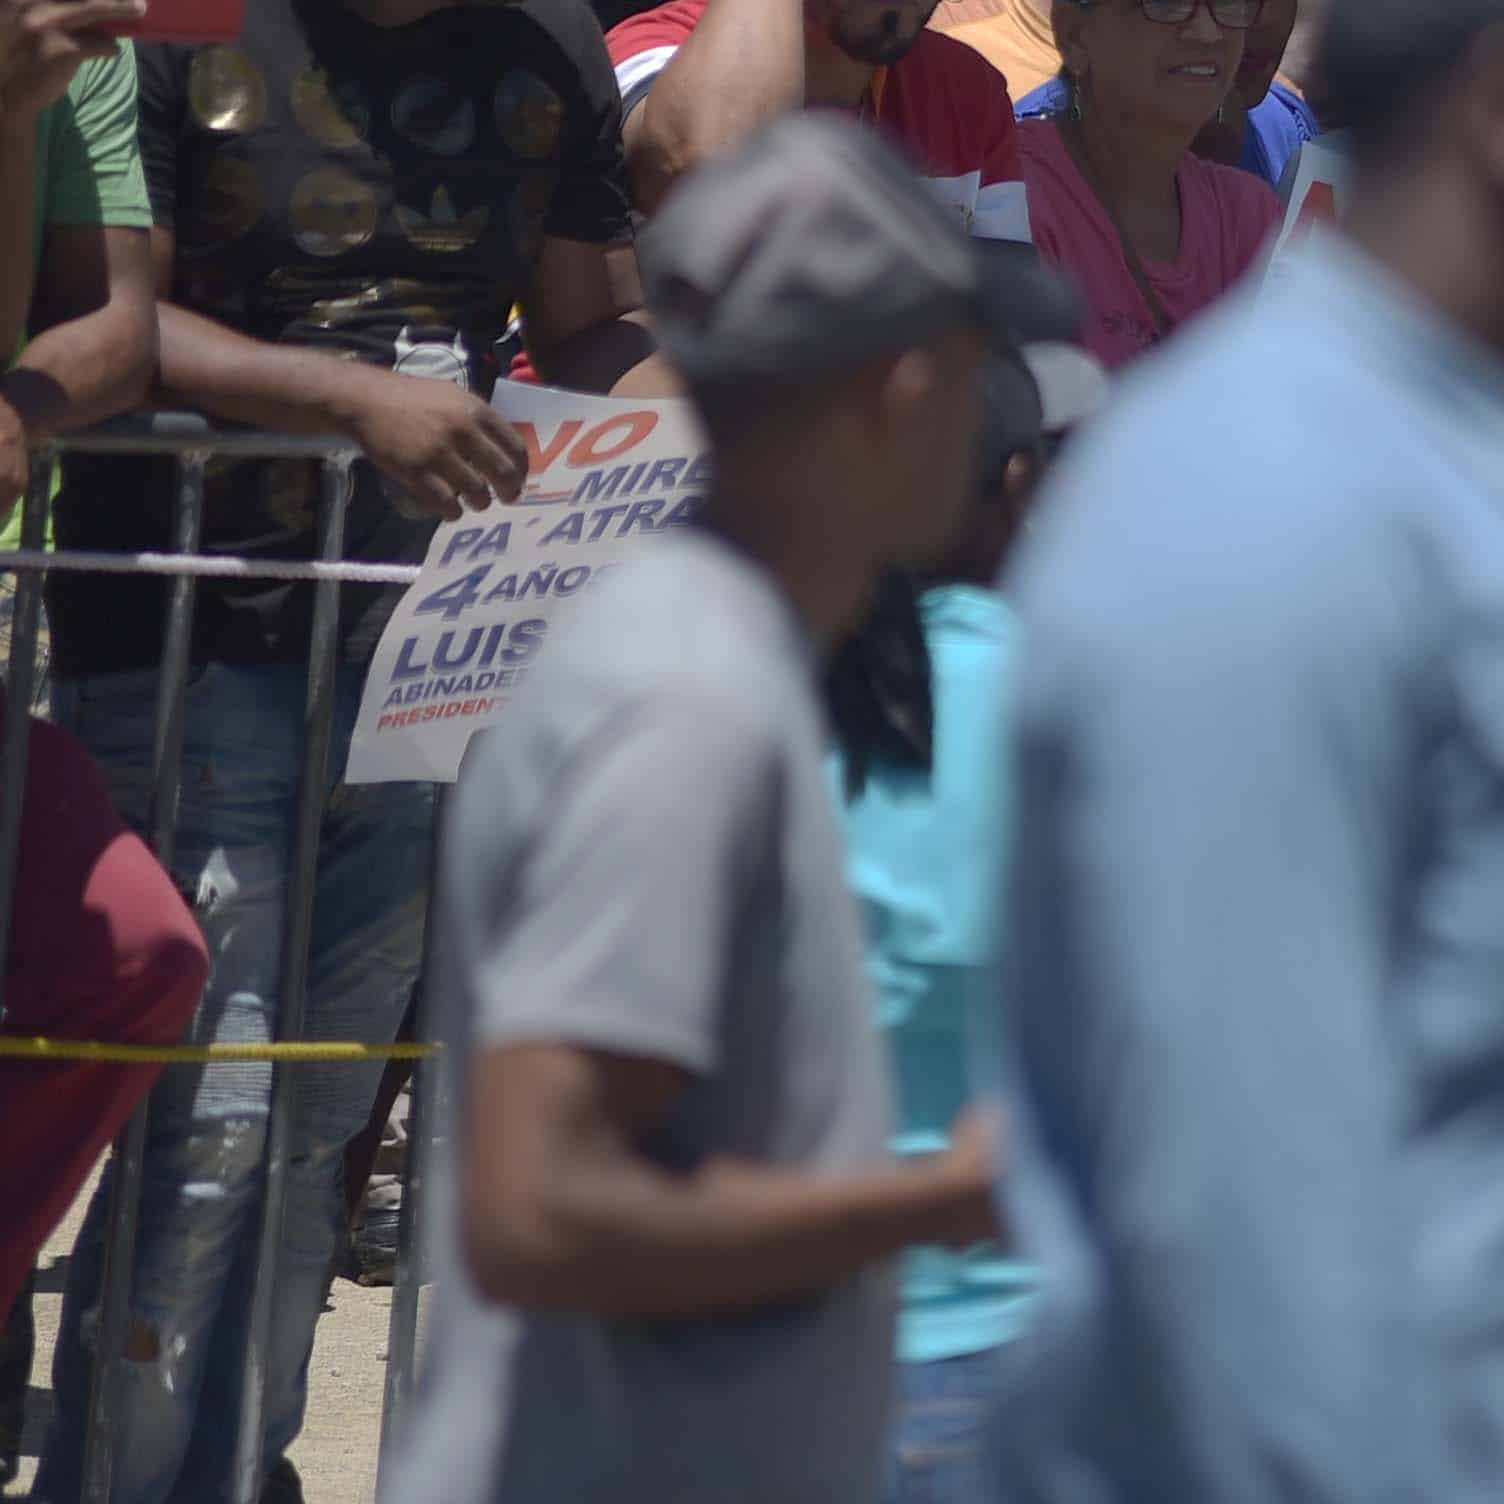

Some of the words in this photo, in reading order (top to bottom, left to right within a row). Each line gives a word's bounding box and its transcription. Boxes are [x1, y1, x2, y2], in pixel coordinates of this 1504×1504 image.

[439, 517, 541, 567] PA'
[413, 562, 496, 622] 4
[390, 617, 549, 685] LUIS
